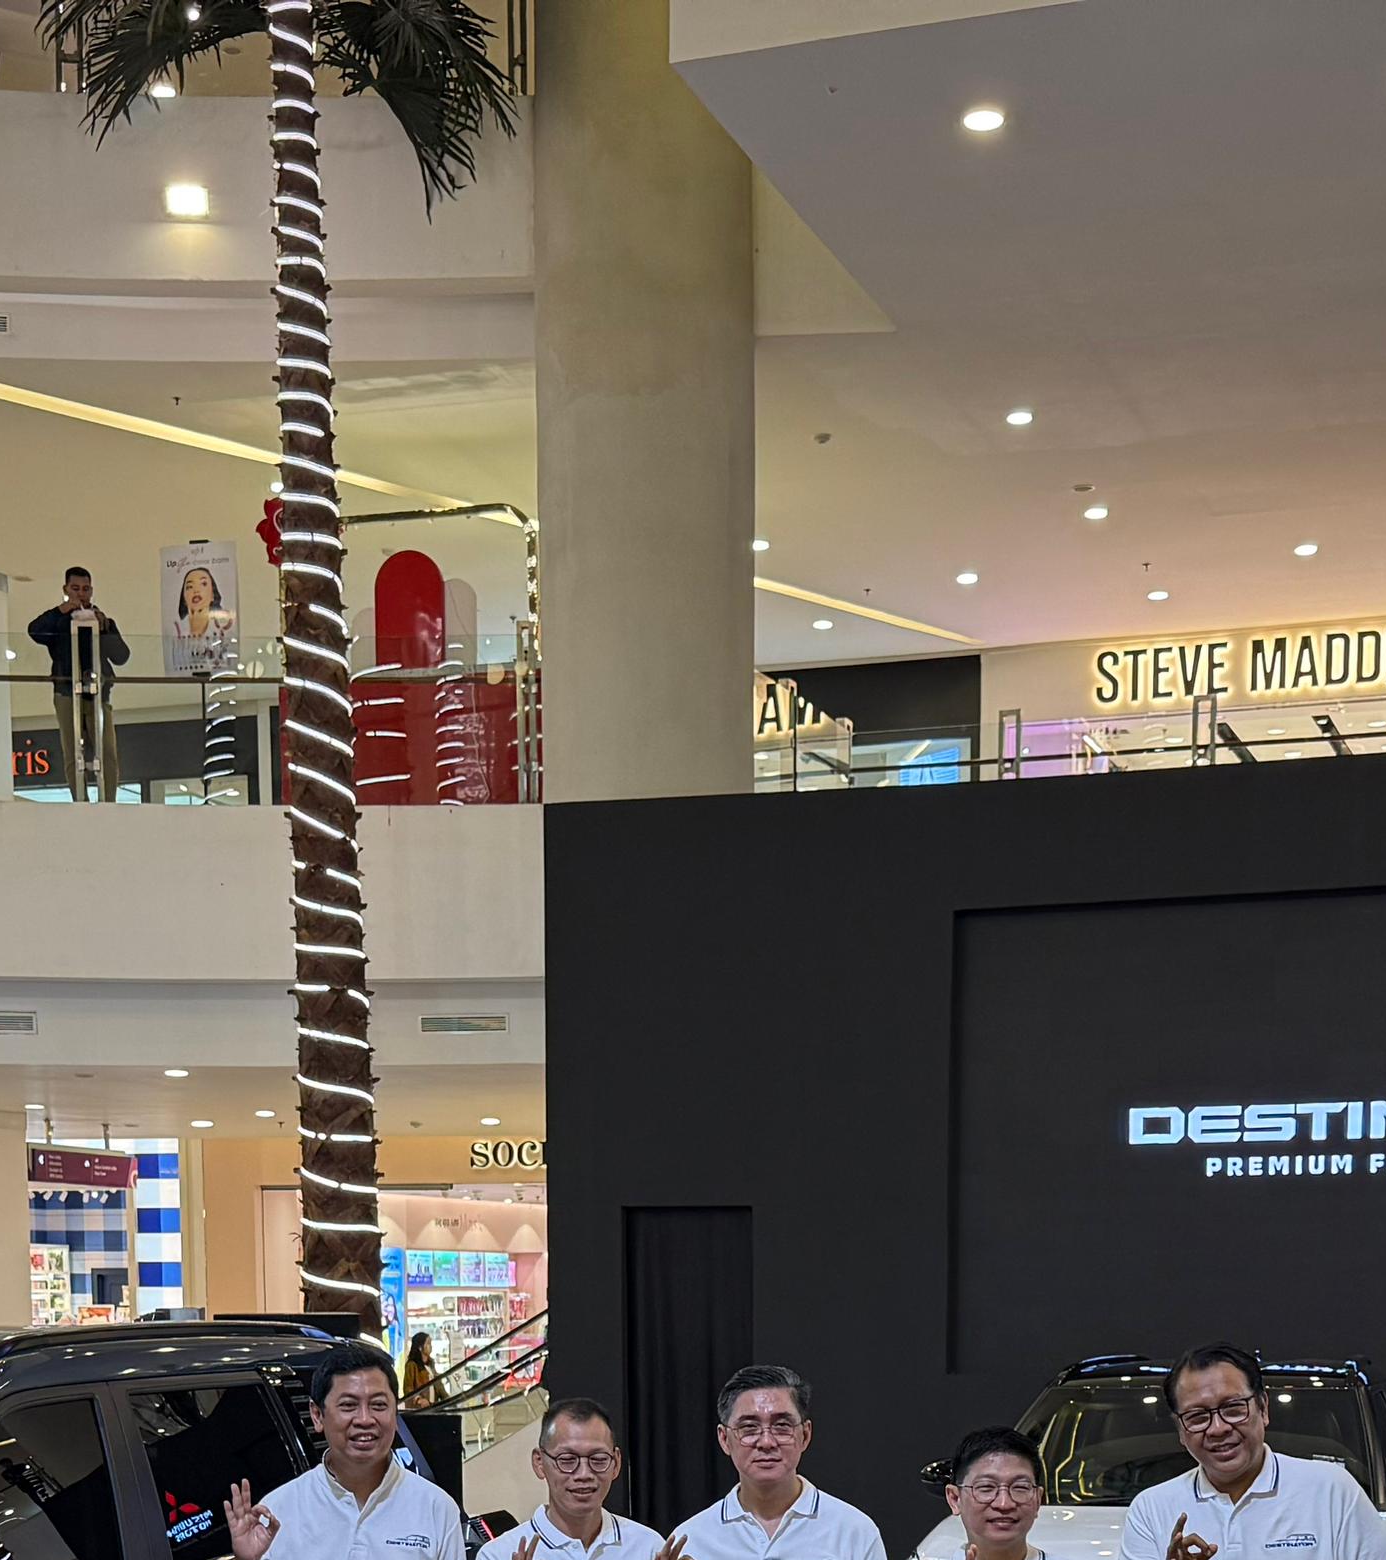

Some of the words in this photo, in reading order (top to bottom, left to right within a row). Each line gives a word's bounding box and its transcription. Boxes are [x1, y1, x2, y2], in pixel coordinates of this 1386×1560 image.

[1095, 641, 1228, 703] STEVE
[11, 739, 50, 776] ris
[1206, 1153, 1353, 1177] PREMIUM
